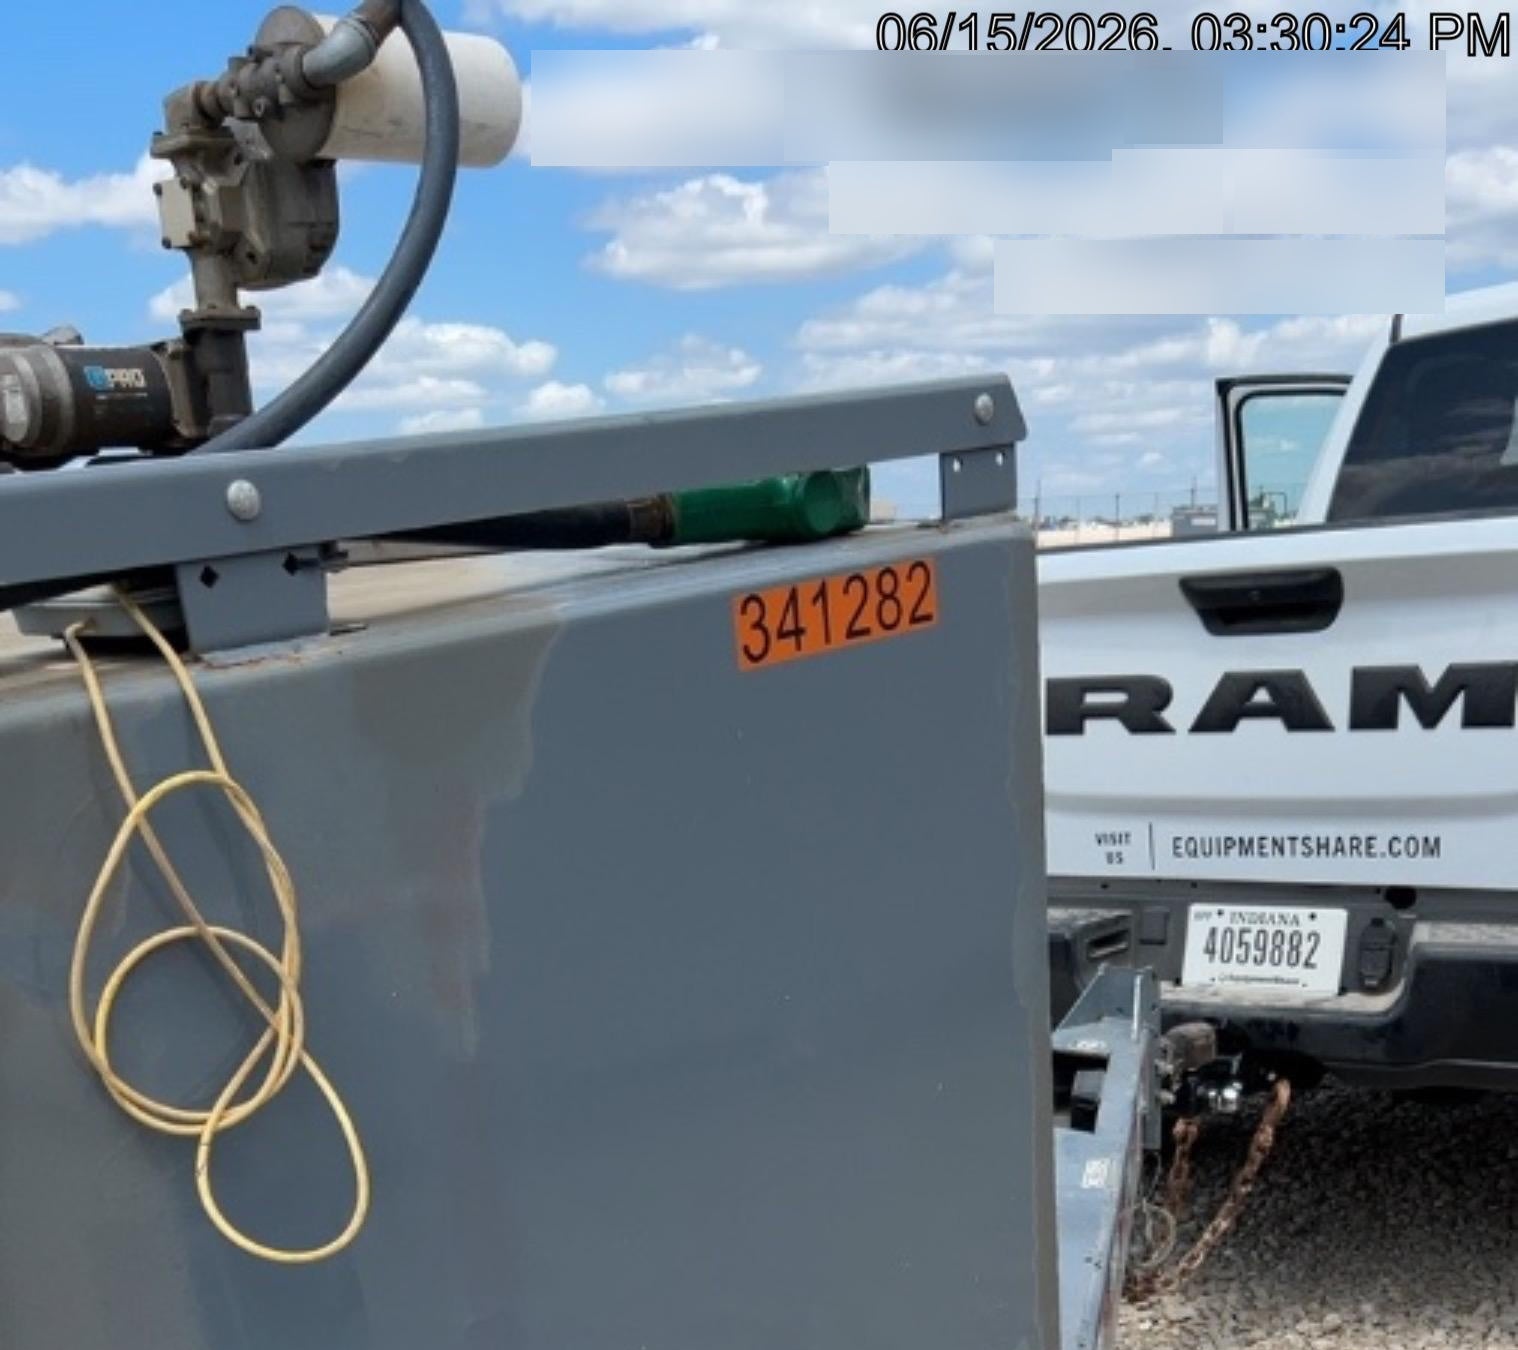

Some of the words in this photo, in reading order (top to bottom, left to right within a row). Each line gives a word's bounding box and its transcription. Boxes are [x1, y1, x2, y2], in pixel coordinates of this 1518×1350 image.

[740, 560, 934, 664] 341282
[1045, 659, 1518, 735] RAM
[1095, 832, 1131, 846] VISIT
[1172, 836, 1441, 858] EQUIPMENTSHARE.COM
[1203, 926, 1321, 969] 4059882
